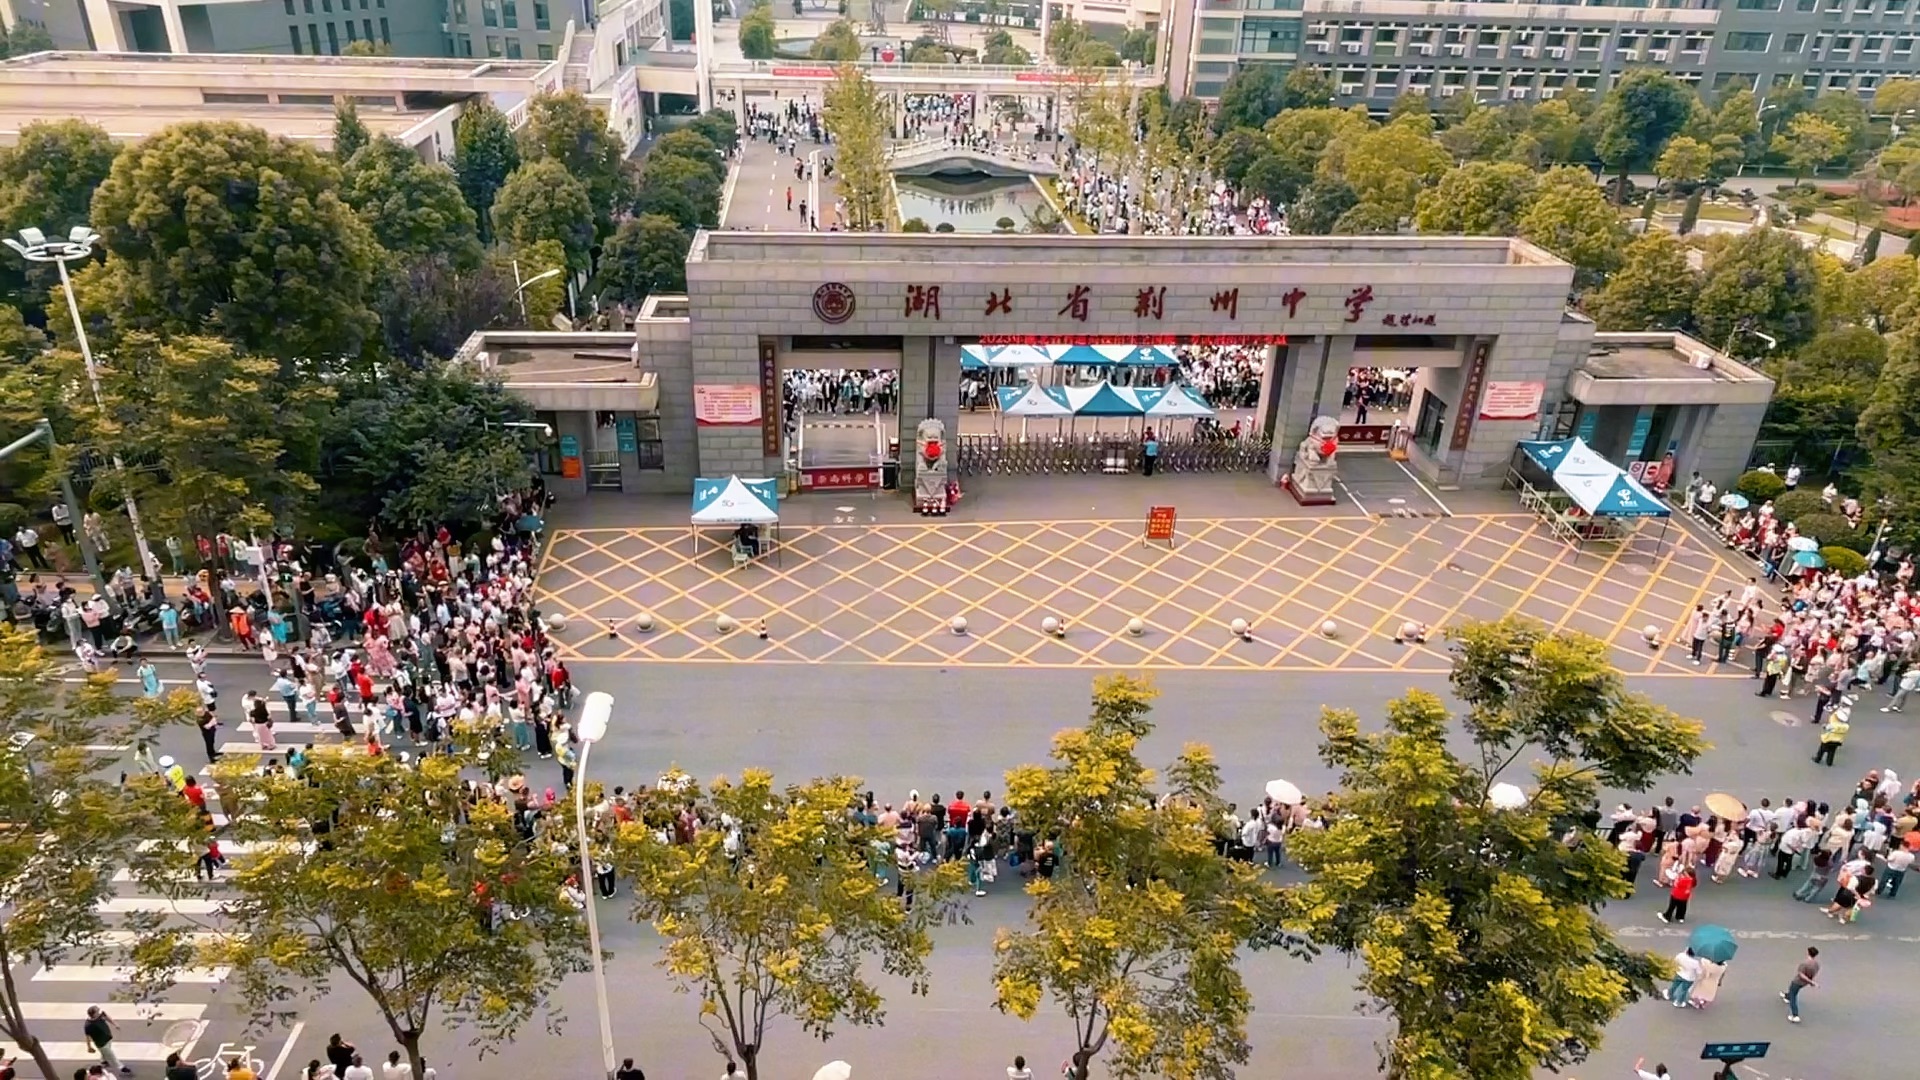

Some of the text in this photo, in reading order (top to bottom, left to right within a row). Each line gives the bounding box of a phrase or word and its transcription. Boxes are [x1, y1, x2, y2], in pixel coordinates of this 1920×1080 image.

[904, 285, 1374, 323] 湖北省荆州中学
